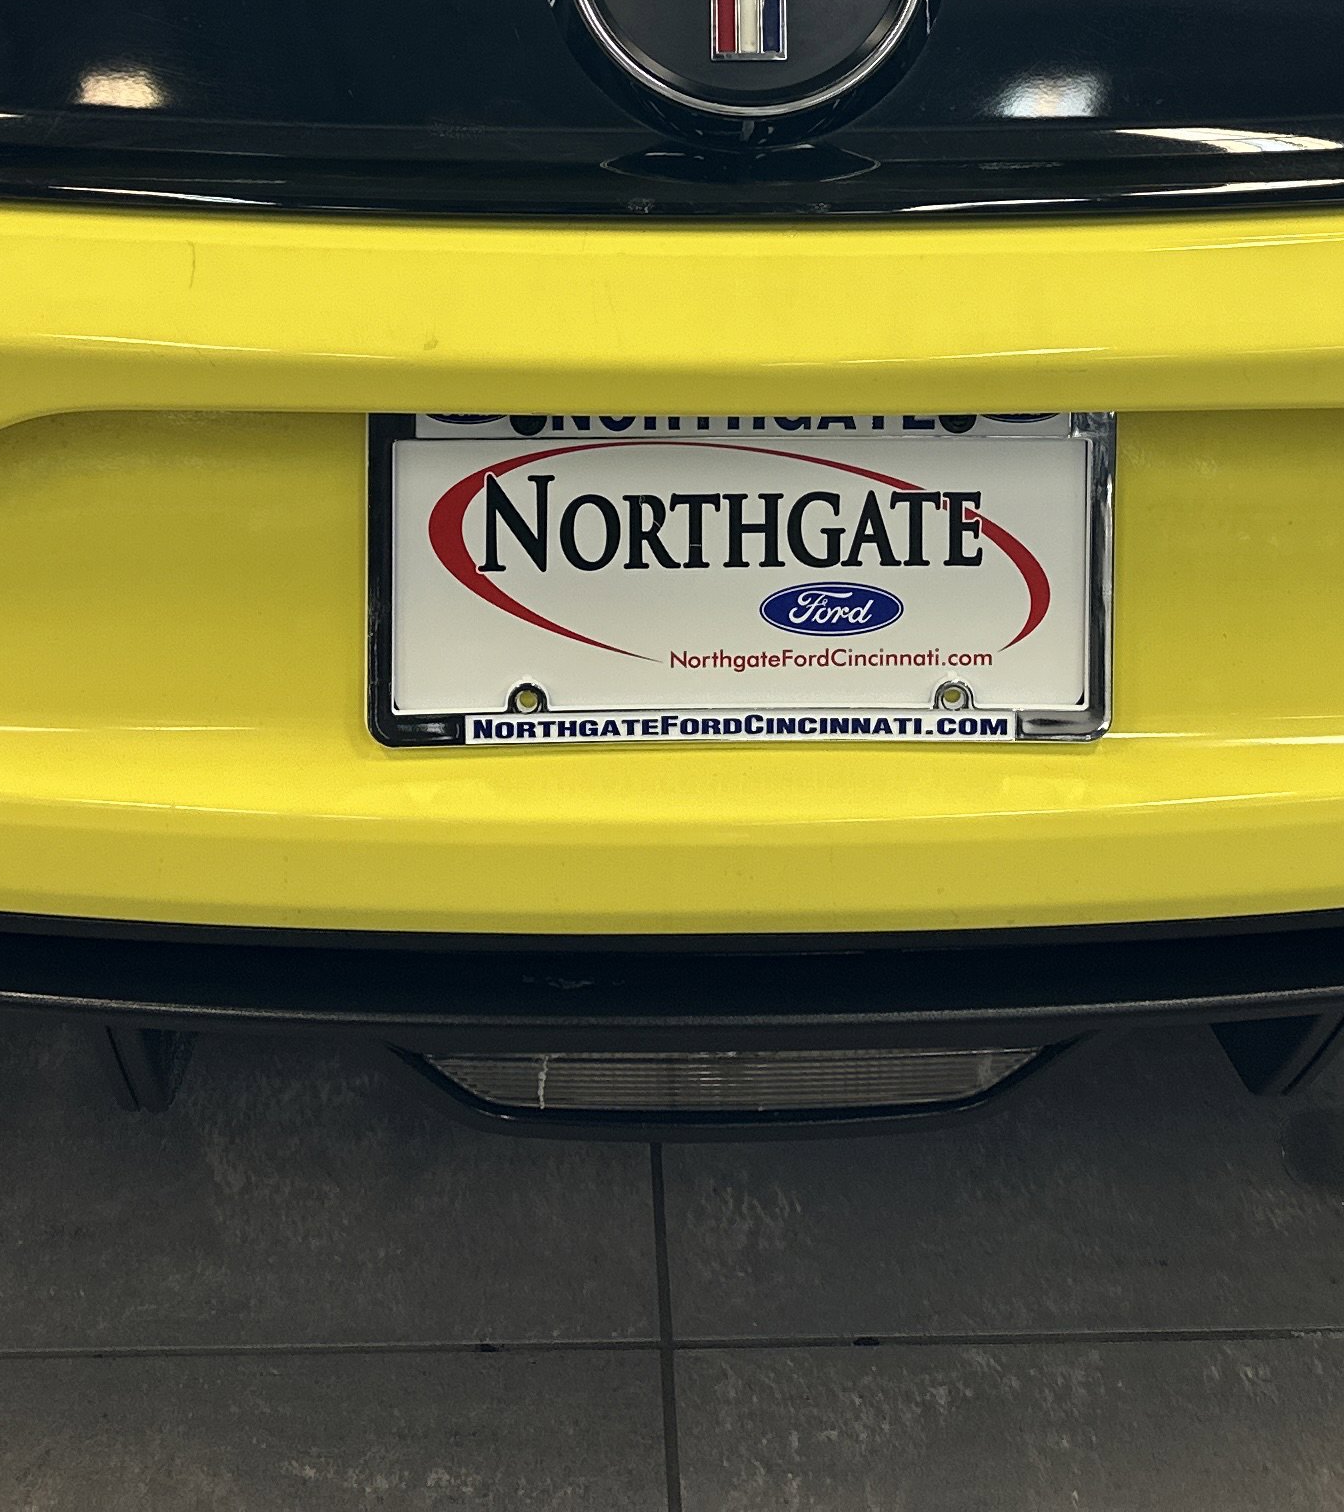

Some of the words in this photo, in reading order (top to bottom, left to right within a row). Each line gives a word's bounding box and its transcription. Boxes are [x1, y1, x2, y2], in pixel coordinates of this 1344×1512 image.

[478, 474, 984, 573] NORTHGATE
[788, 590, 872, 626] Ford
[670, 648, 994, 672] NorthgateFordCincinnati.com
[472, 714, 1008, 739] NORTHGATEFORDCINCINNATI.COM
